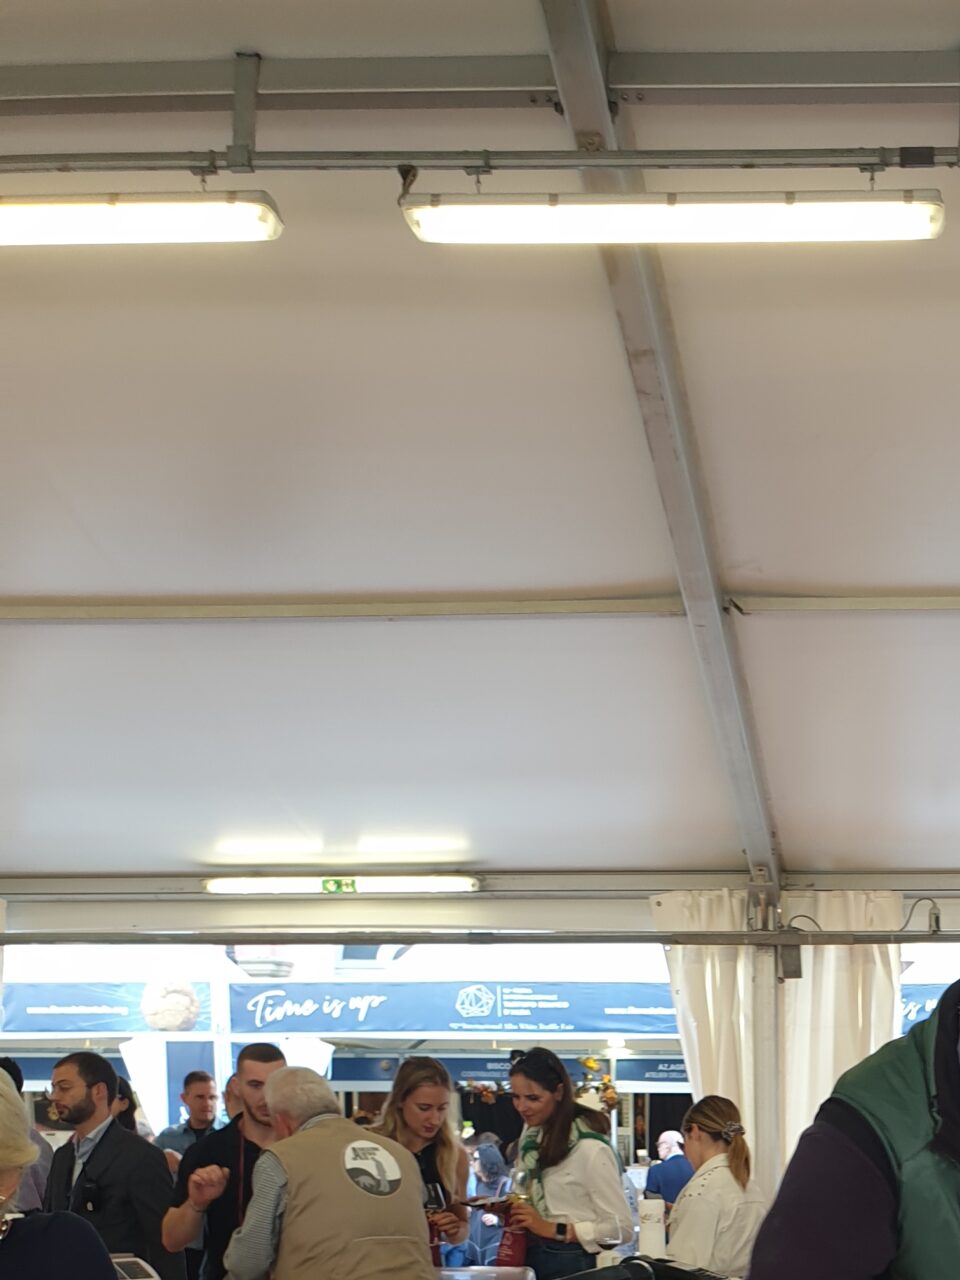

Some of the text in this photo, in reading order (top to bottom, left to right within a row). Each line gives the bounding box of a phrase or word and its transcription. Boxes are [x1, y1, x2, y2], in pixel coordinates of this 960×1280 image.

[247, 989, 387, 1028] Time is up
